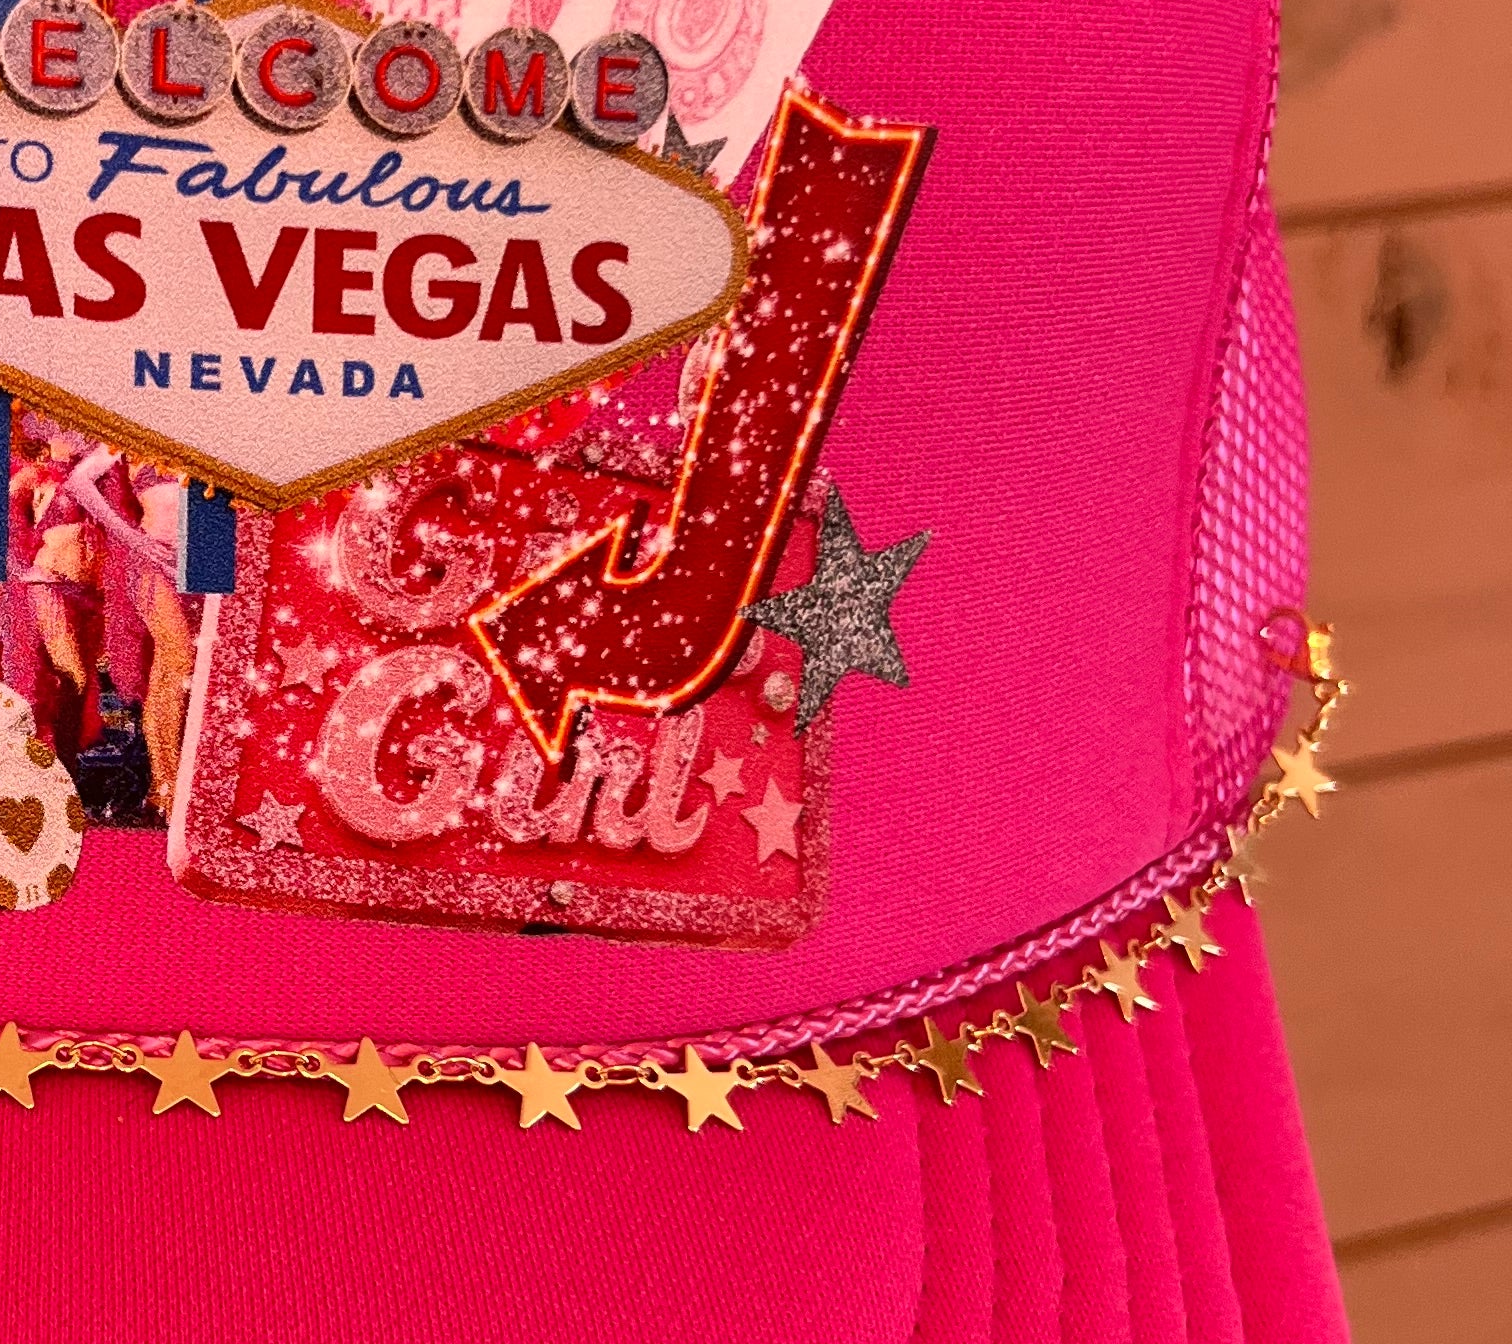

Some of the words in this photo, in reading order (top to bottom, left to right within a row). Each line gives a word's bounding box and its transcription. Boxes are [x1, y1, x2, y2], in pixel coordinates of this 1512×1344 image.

[88, 130, 552, 217] Fabulous
[199, 218, 634, 345] VEGAS
[133, 348, 426, 400] NEVADA
[315, 644, 709, 854] Girl
